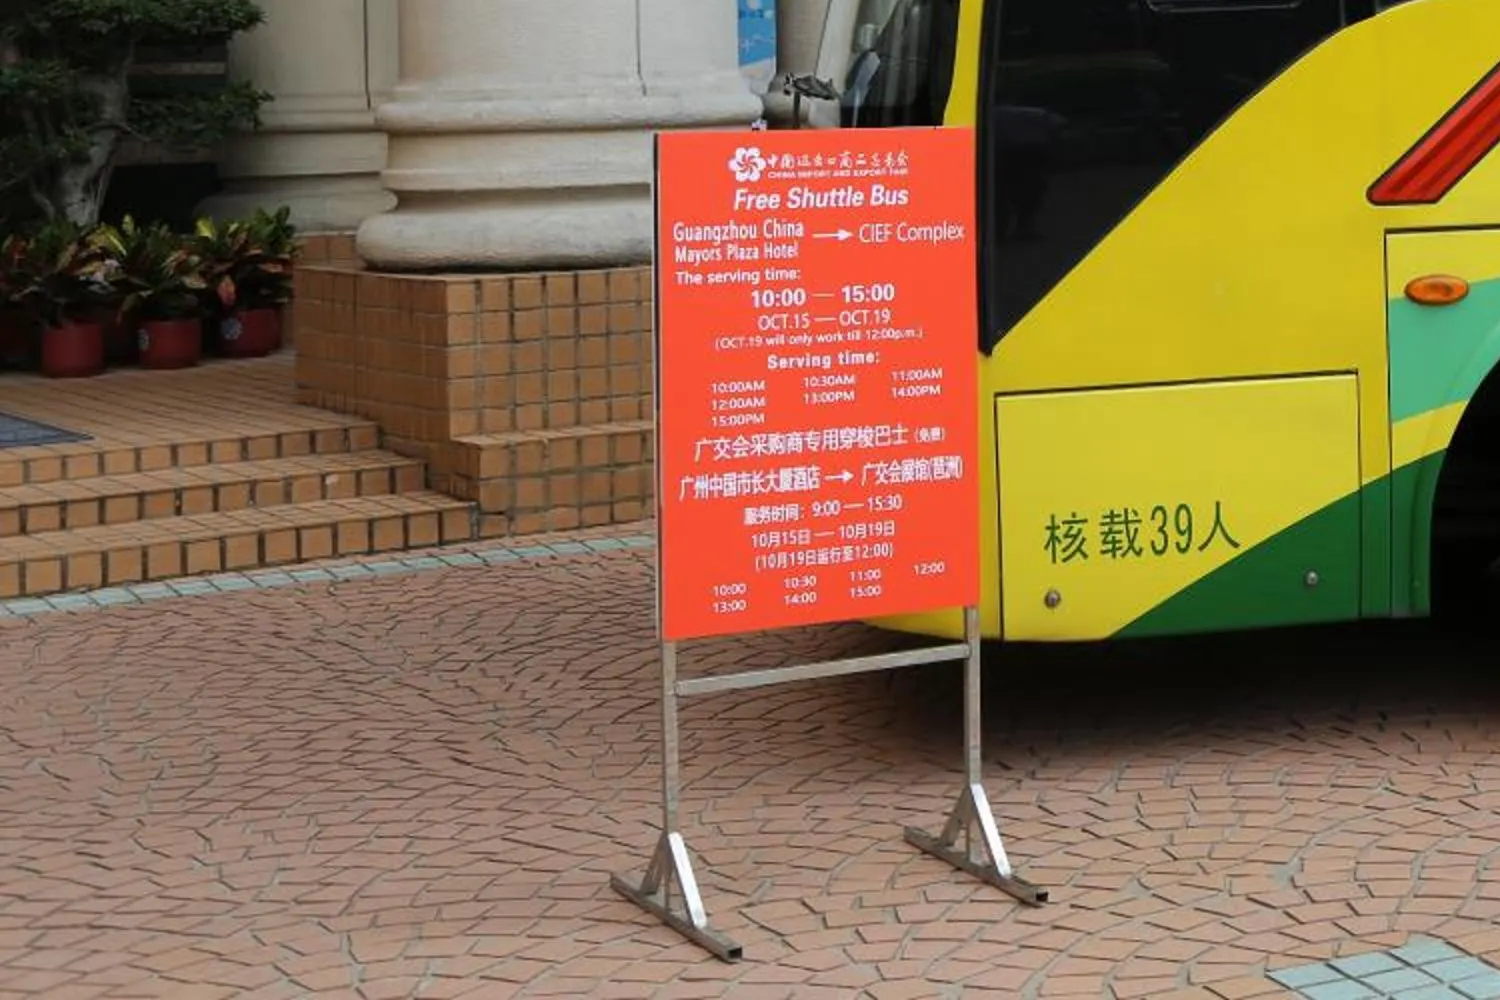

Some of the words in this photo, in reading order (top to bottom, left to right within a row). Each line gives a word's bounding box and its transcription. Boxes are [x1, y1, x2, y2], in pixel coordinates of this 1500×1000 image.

[734, 188, 781, 212] Free
[787, 185, 864, 209] Shuttle
[870, 184, 909, 206] Bus
[673, 220, 757, 246] Guangzhou
[763, 218, 805, 239] China
[858, 223, 894, 243] CIEF
[896, 220, 965, 244] Complex
[675, 244, 722, 266] Mayors
[727, 243, 759, 260] Plaza
[763, 240, 799, 259] Hotel
[676, 270, 703, 285] The
[707, 268, 760, 285] serving
[765, 266, 801, 281] time:
[751, 288, 806, 309] 10:00
[841, 283, 895, 304] 15:00
[757, 313, 810, 331] OCT.15
[839, 308, 891, 326] OCT.19
[765, 334, 785, 347] will
[789, 333, 813, 347] only
[816, 330, 843, 343] work
[767, 353, 831, 369] Serving
[838, 350, 880, 365] time:
[711, 380, 765, 394] 10:00AM
[711, 397, 766, 410] 12:00AM
[711, 413, 765, 427] 15:00PM
[694, 424, 908, 462] 广交会采购商专用穿梭巴士
[679, 466, 821, 500] 广州中国市长大厦酒店
[811, 500, 841, 517] 9:00
[867, 494, 903, 512] 15:30
[751, 528, 811, 548] 10月15日
[838, 520, 896, 539] 10月19日
[1043, 500, 1241, 564] 核载39人
[712, 583, 747, 597] 10:00
[849, 568, 881, 582] 11:00
[913, 561, 945, 575] 12:00
[712, 599, 747, 613] 13:00
[783, 591, 817, 605] 14:00
